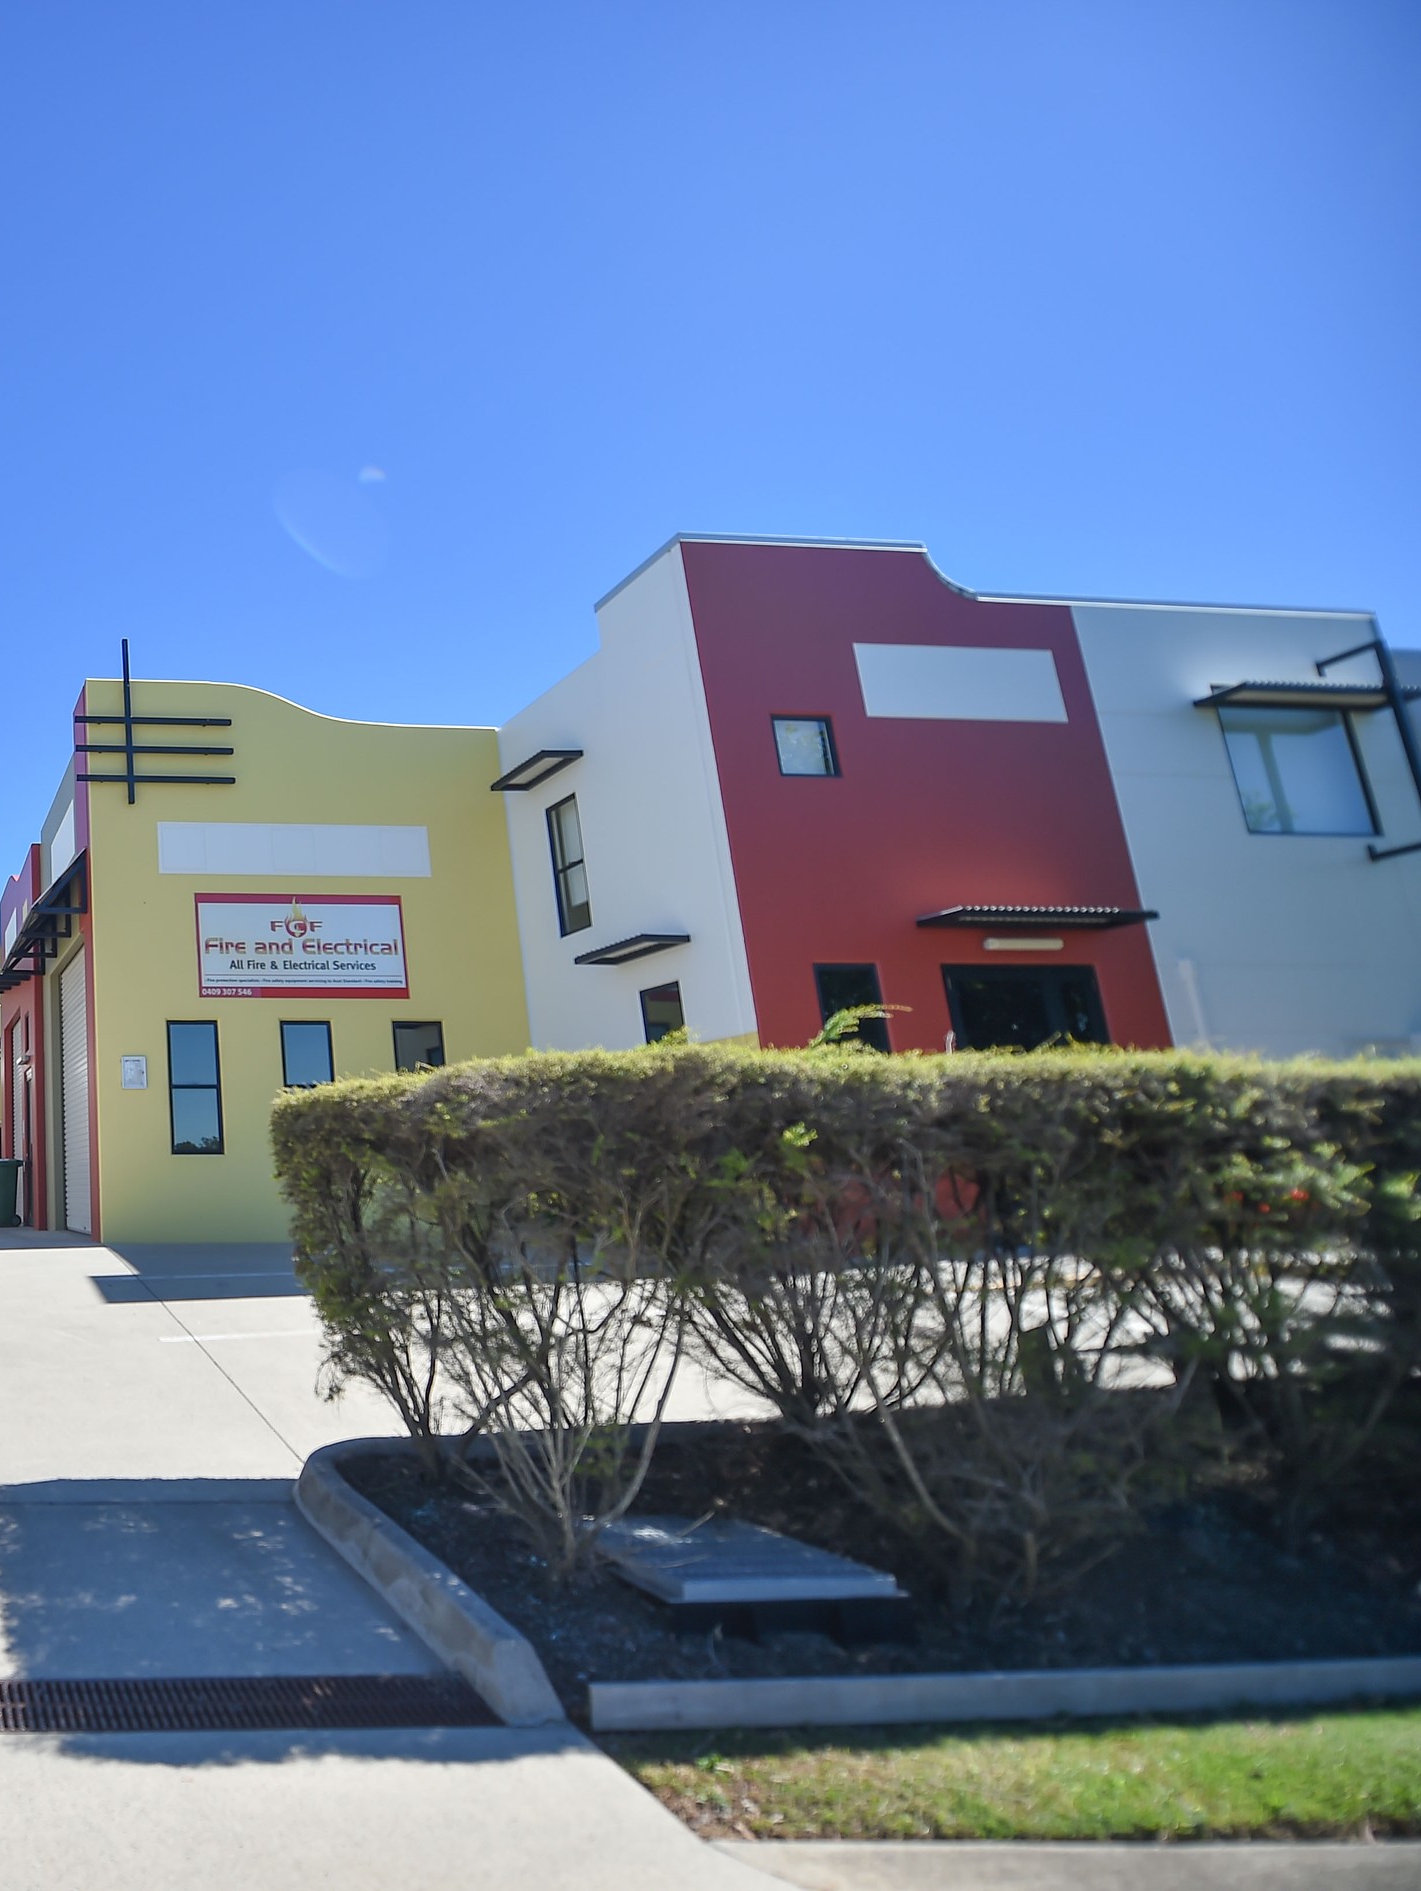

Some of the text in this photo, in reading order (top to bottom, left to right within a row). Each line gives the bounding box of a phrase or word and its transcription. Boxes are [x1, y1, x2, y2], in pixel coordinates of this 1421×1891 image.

[204, 937, 399, 956] Fire and Electrical
[229, 959, 377, 971] All Fire & Electrical Services
[202, 988, 253, 996] 0409 307 546
